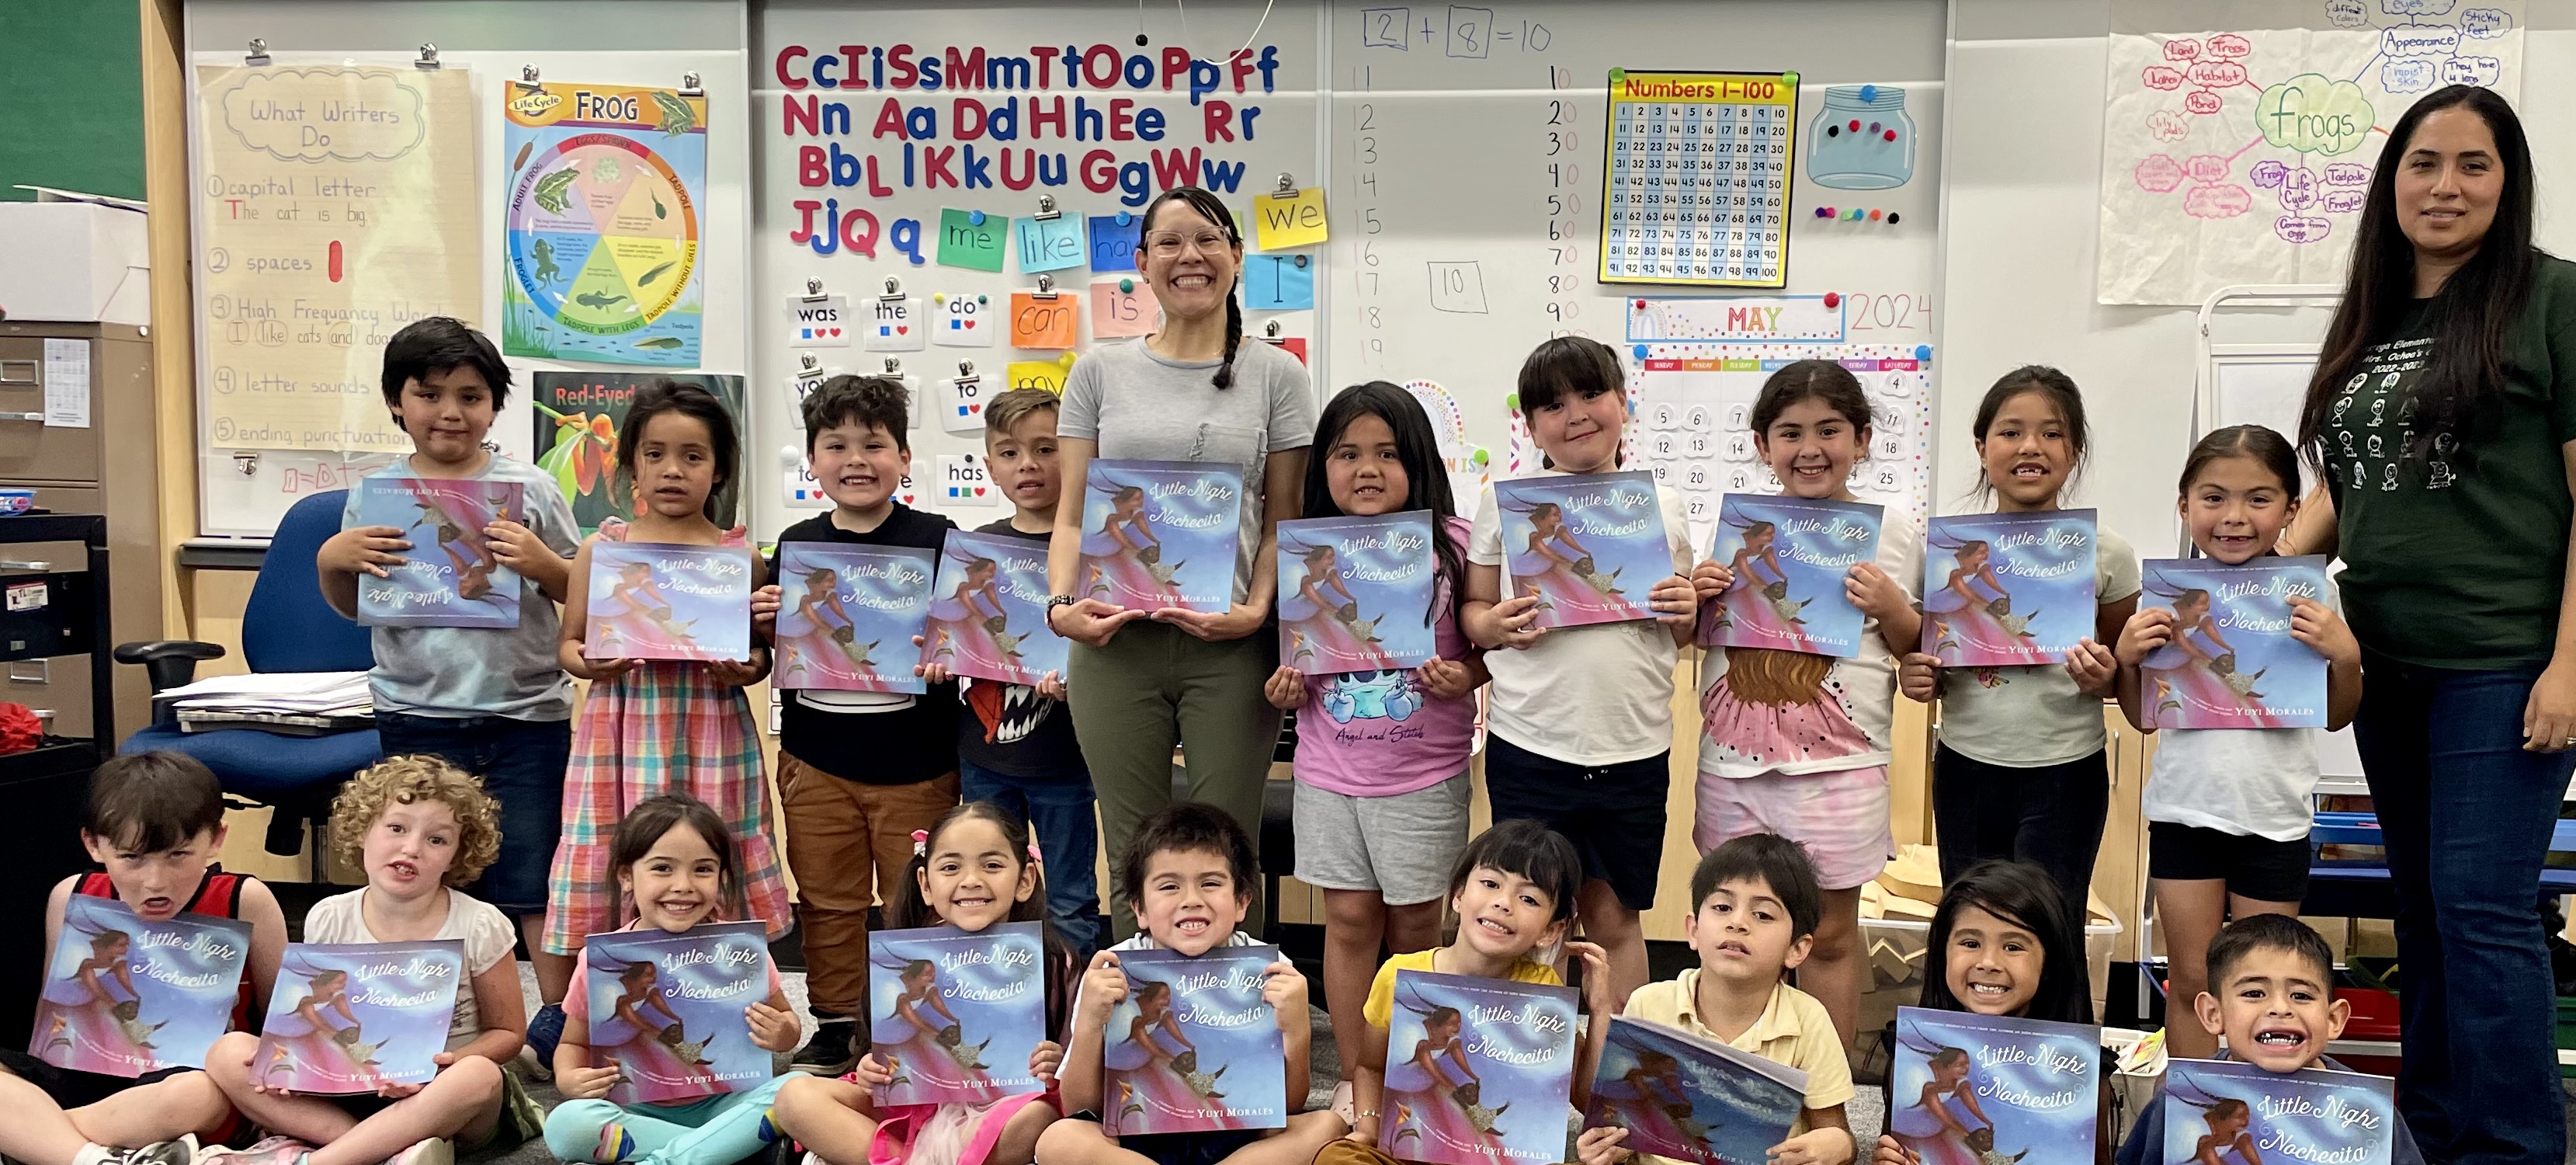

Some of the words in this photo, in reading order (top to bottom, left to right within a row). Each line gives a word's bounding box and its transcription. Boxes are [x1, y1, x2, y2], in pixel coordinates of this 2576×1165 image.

[1377, 13, 1397, 42] 2
[1457, 23, 1477, 52] 8
[1522, 19, 1551, 52] 10
[2385, 31, 2455, 52] Appearance
[1626, 79, 1714, 98] Numbers
[1722, 82, 1774, 99] 1-100
[250, 100, 306, 121] What
[323, 100, 400, 123] Writers
[514, 100, 533, 110] Life
[533, 96, 560, 108] Cycle
[576, 92, 638, 120] FROG
[2271, 86, 2356, 153] frogs
[302, 126, 331, 147] Do
[1719, 144, 1731, 152] 27
[1754, 145, 1766, 154] 29
[1771, 145, 1783, 154] 30
[230, 177, 294, 202] capital
[315, 177, 376, 197] letter
[512, 183, 528, 211] ADULT
[526, 162, 543, 183] FROG
[668, 173, 691, 210] TADPOLE
[2286, 175, 2310, 191] Life
[224, 200, 259, 220] The
[277, 202, 300, 220] cat
[318, 210, 330, 221] is
[950, 225, 994, 249] me
[1022, 224, 1080, 266] like
[247, 257, 312, 277] spaces
[514, 258, 535, 294] FROGLET
[646, 297, 672, 321] TADPOLE
[672, 266, 690, 298] WITHOUT
[687, 243, 696, 263] GILLS
[1274, 256, 1283, 303] I
[1443, 268, 1463, 297] 10
[238, 298, 276, 325] High
[798, 308, 837, 322] was
[876, 304, 907, 319] the
[950, 297, 975, 315] do
[1111, 291, 1139, 321] is
[1850, 294, 1932, 333] 2024
[563, 317, 594, 334] TADPOLE
[599, 325, 619, 334] WITH
[622, 321, 639, 333] LEGS
[1017, 305, 1070, 336] can
[1728, 307, 1783, 331] MAY
[233, 322, 241, 342] I
[262, 323, 285, 343] like
[297, 325, 321, 344] cats
[331, 327, 353, 344] and
[246, 372, 298, 393] letter
[311, 376, 370, 395] sounds
[958, 383, 977, 398] to
[1893, 378, 1899, 388] 4
[556, 384, 635, 412] Red-Eyed
[1661, 413, 1667, 423] 5
[239, 424, 293, 444] ending
[1658, 442, 1669, 453] 12
[1692, 440, 1703, 451] 13
[1732, 443, 1744, 454] 14
[1885, 443, 1897, 453] 18
[949, 464, 983, 481] has
[1691, 473, 1703, 483] 20
[1880, 473, 1893, 485] 25
[1150, 481, 1187, 501] Little
[1187, 478, 1232, 501] Night
[1149, 506, 1224, 528] Nochecita
[1691, 504, 1703, 515] 27
[1340, 536, 1378, 558] Little
[1378, 530, 1424, 553] Night
[1342, 562, 1417, 581] Nochecita
[2217, 580, 2261, 603] Little
[2262, 576, 2315, 599] Night
[2236, 707, 2262, 716] YUYI
[1335, 728, 1363, 746] Angel
[1367, 729, 1384, 740] and
[1390, 724, 1425, 742] Stitch
[940, 949, 983, 973] Little
[984, 944, 1033, 969] Night
[944, 979, 1026, 1000] Nochecita
[1468, 1004, 1512, 1027] Little
[1513, 1003, 1566, 1033] Night
[1467, 1035, 1554, 1065] Nochecita
[1977, 1045, 2026, 1068] Little
[2027, 1043, 2087, 1075] Night
[1978, 1076, 2076, 1108] Nochecita
[2257, 1095, 2312, 1120] Little
[2313, 1095, 2380, 1130] Night
[1474, 1144, 1500, 1156] YUYI
[1503, 1147, 1552, 1160] MORALES
[2259, 1129, 2367, 1165] Nochecita
